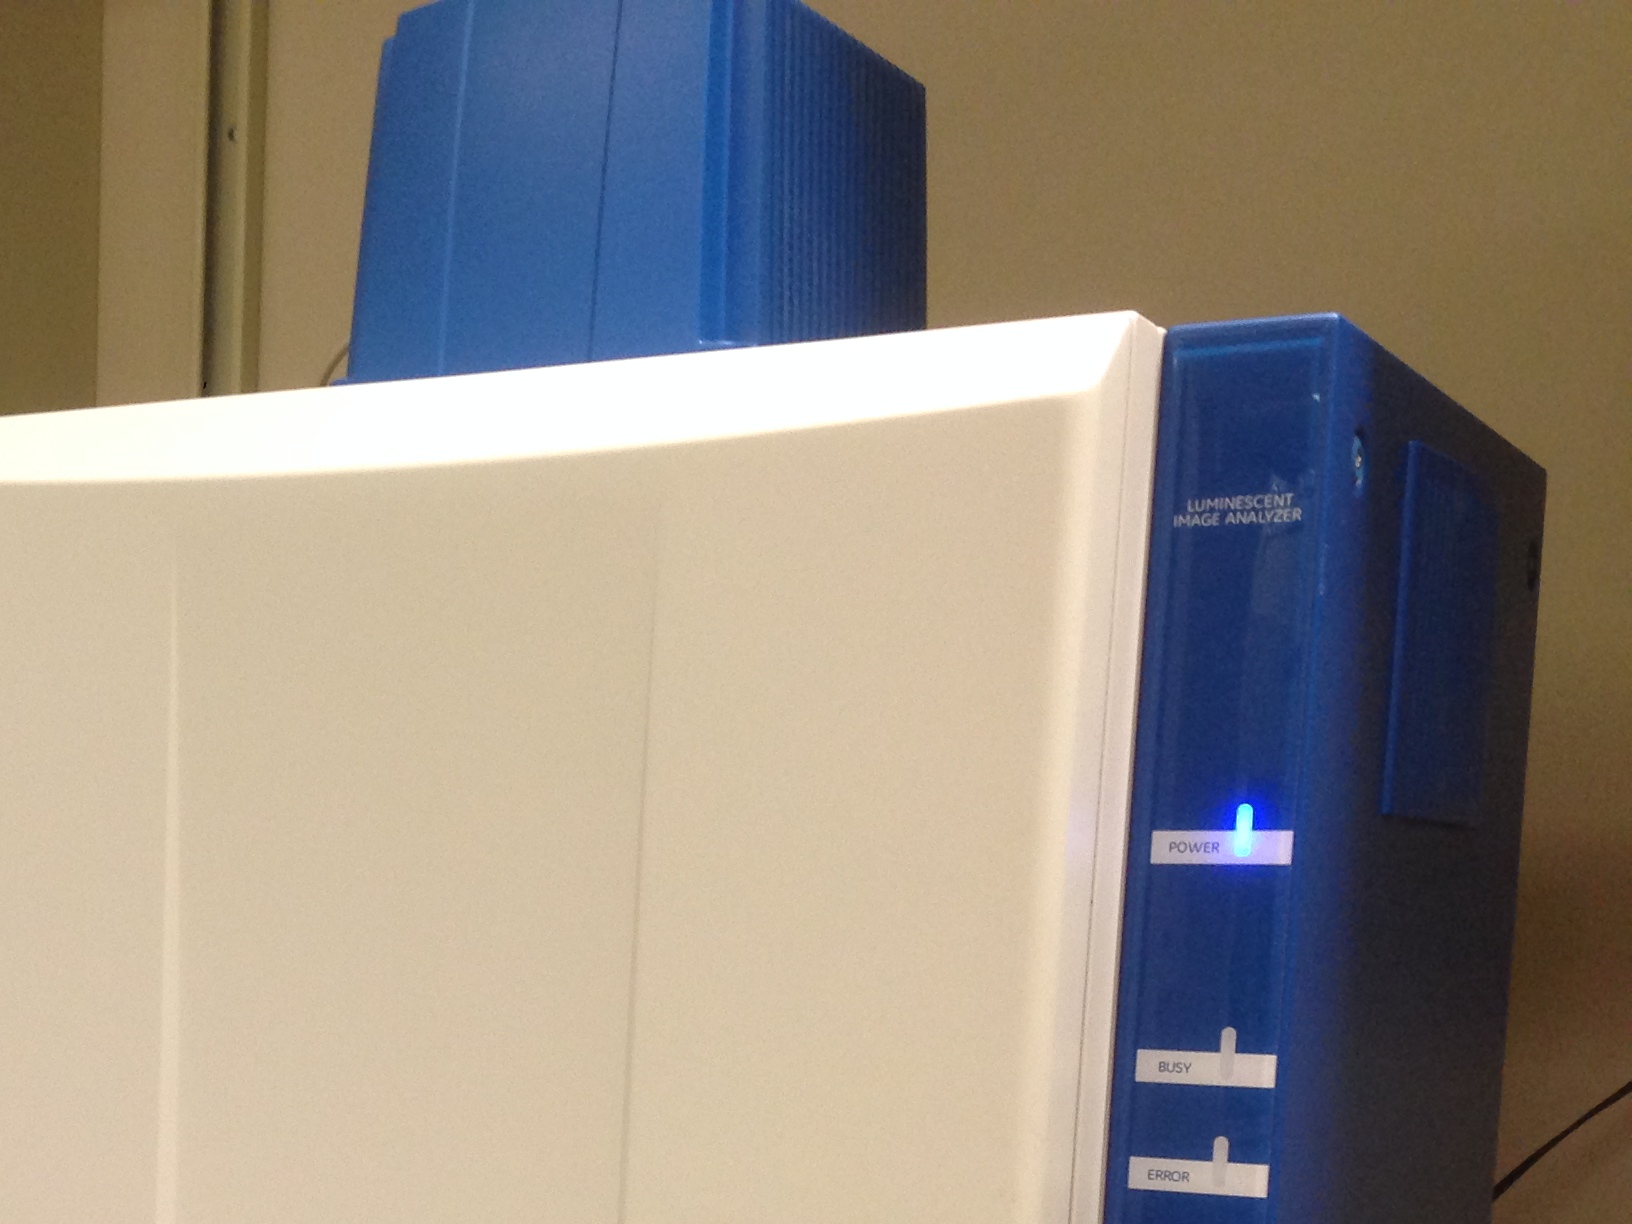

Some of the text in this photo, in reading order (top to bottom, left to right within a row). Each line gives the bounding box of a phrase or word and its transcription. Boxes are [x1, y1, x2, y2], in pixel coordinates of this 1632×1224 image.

[1186, 493, 1294, 513] LUMINESCENT
[1173, 507, 1303, 528] IMAGE ANALYZER
[1168, 841, 1220, 854] POWER
[1158, 1061, 1192, 1074] BUSY
[1147, 1168, 1190, 1183] ERROR
